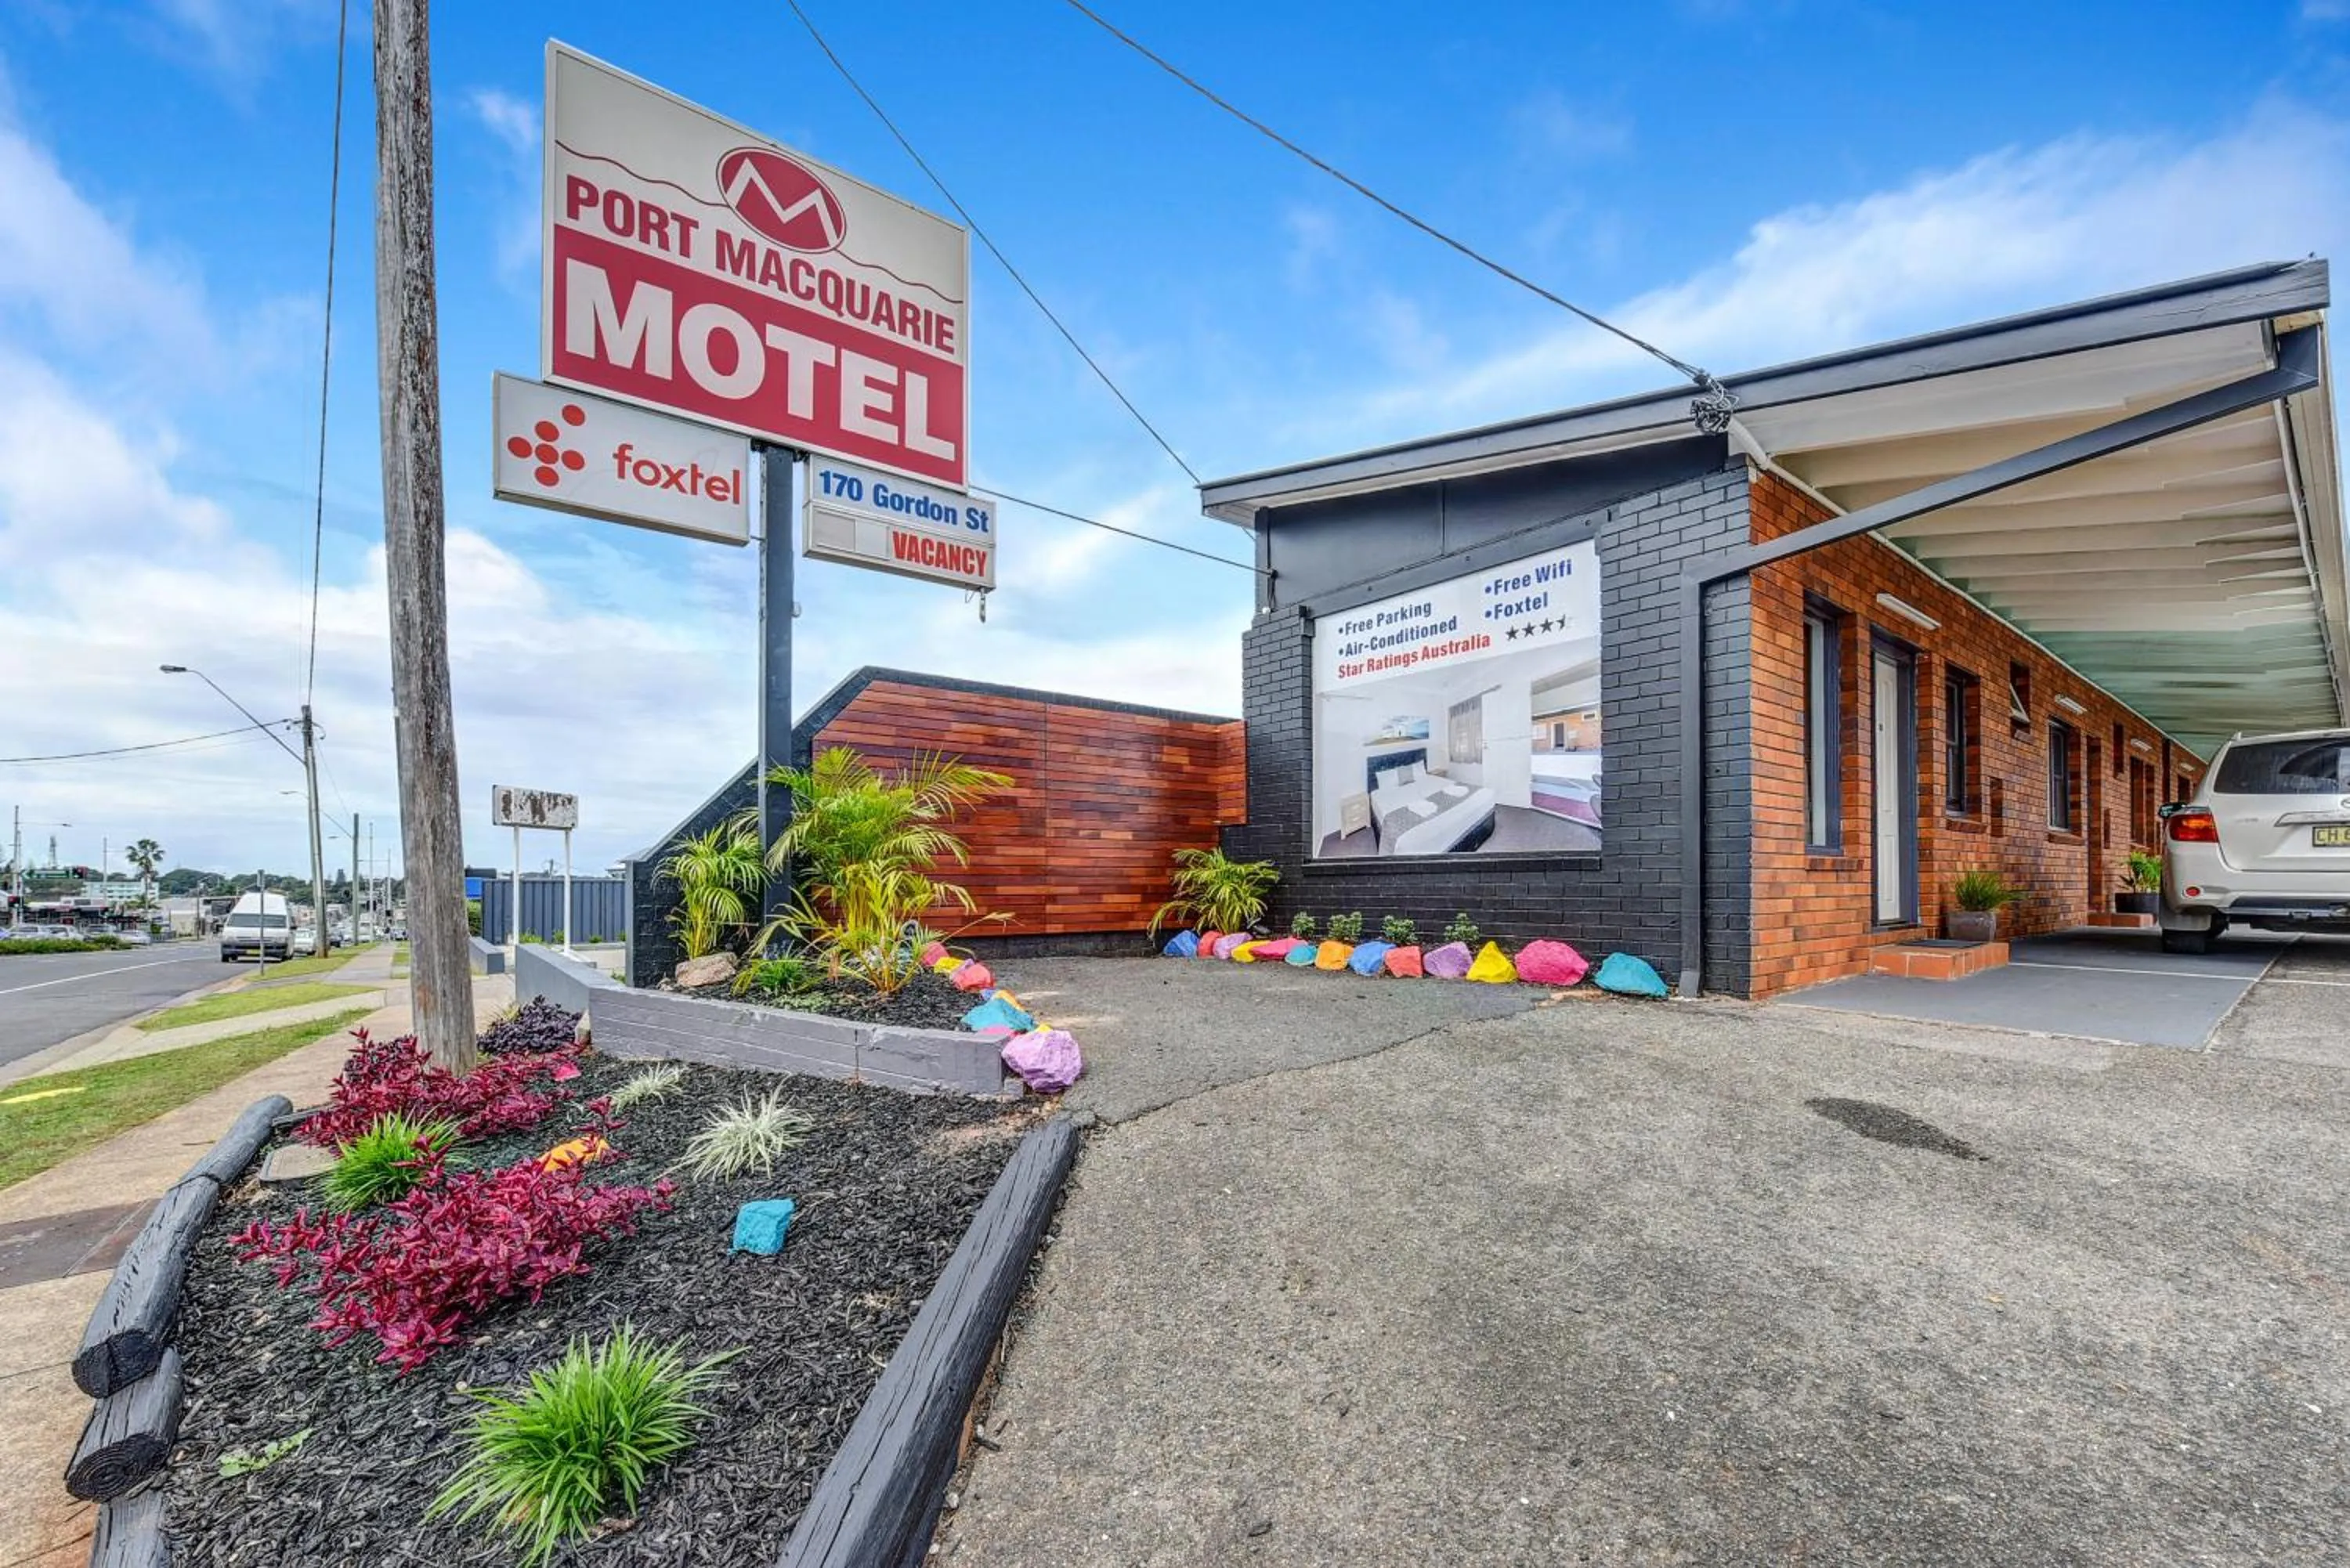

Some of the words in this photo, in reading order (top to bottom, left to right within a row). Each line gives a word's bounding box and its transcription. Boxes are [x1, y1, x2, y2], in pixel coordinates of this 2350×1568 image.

[566, 174, 700, 258] PORT
[715, 228, 956, 355] MACQUARIE
[564, 257, 956, 462] MOTEL
[612, 443, 740, 505] foxtel
[819, 470, 863, 501] 170
[873, 482, 958, 526] Gordon
[965, 507, 989, 533] St
[892, 531, 988, 577] VACANCY
[1494, 574, 1531, 596] Free
[1535, 559, 1572, 583] Wifi
[1344, 620, 1374, 636] Free
[1376, 602, 1432, 627] Parking
[1494, 592, 1549, 620] Foxtel
[1338, 662, 1363, 679] Star
[1367, 648, 1419, 674] Ratings
[1422, 633, 1491, 661] Australia
[1344, 616, 1458, 657] Air-Conditioned
